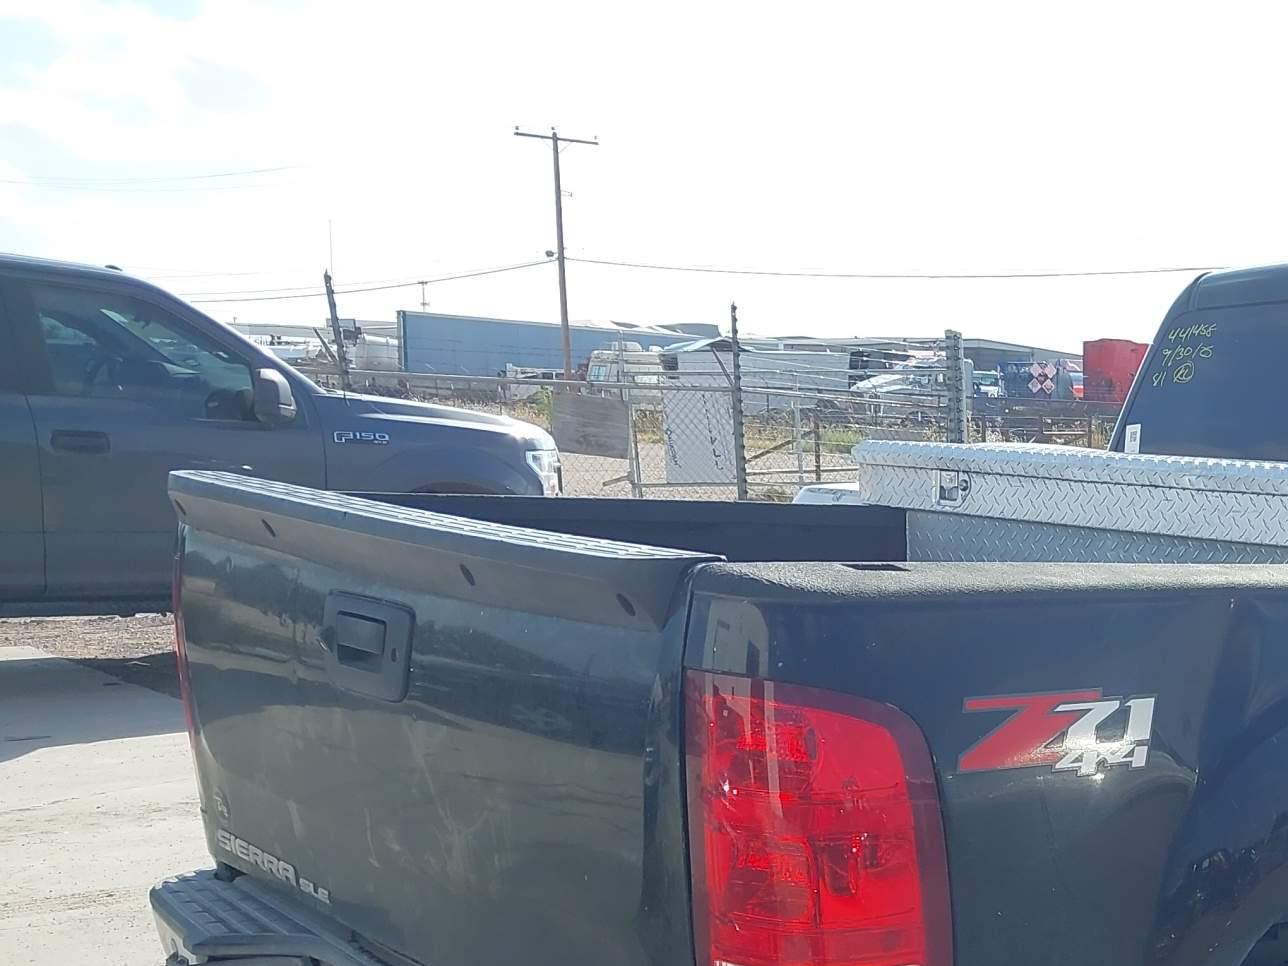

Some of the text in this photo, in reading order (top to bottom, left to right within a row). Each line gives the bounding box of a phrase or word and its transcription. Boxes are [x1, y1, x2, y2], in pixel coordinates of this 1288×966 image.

[958, 688, 1157, 773] Z71
[217, 828, 331, 905] SIERRA SLE
